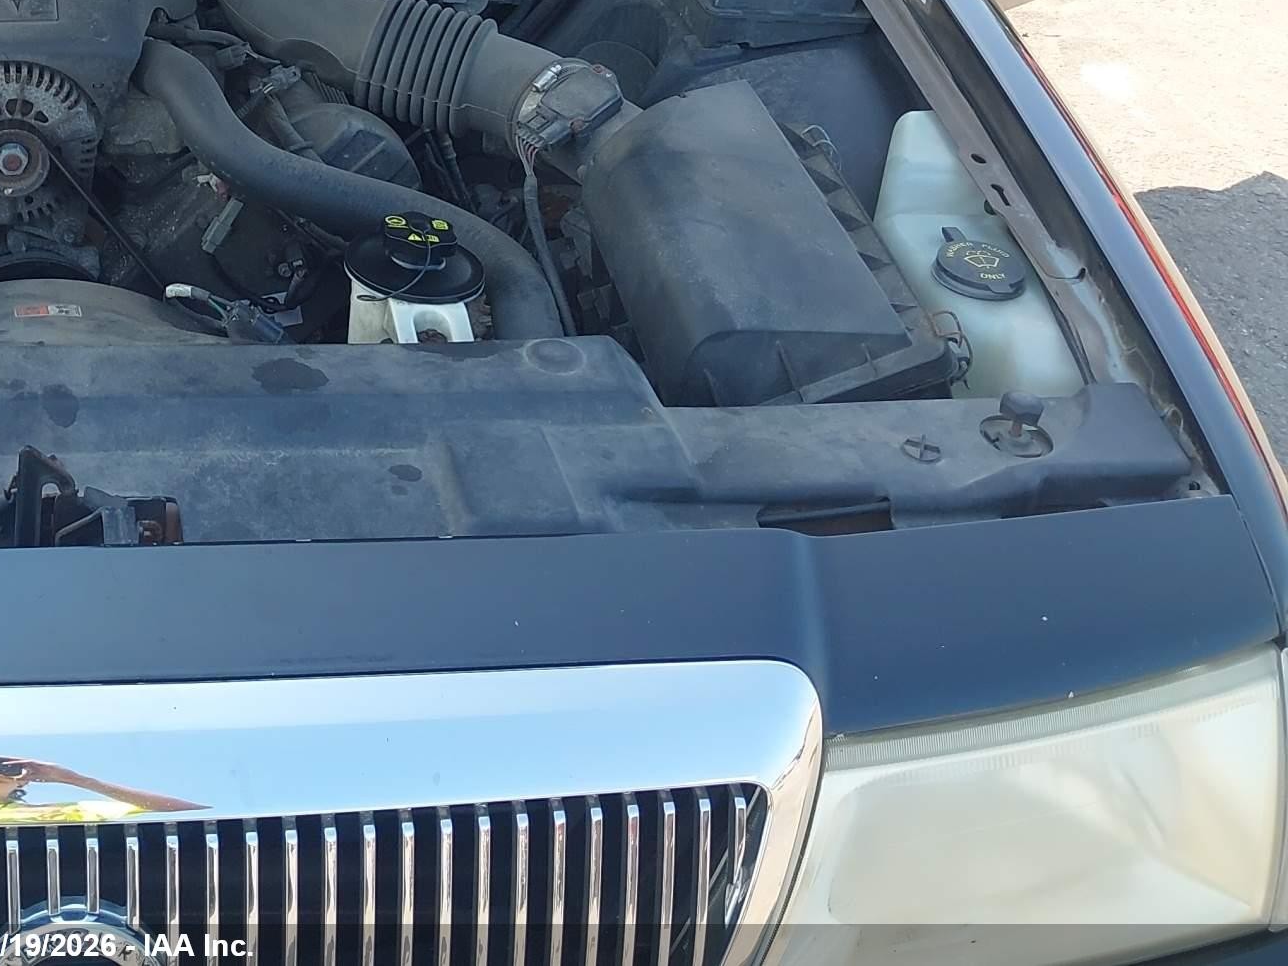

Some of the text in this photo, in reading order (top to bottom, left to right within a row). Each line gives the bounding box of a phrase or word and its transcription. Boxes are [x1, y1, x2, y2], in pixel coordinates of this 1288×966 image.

[946, 242, 1010, 258] WASHER FLUID
[980, 273, 1006, 281] ONLY
